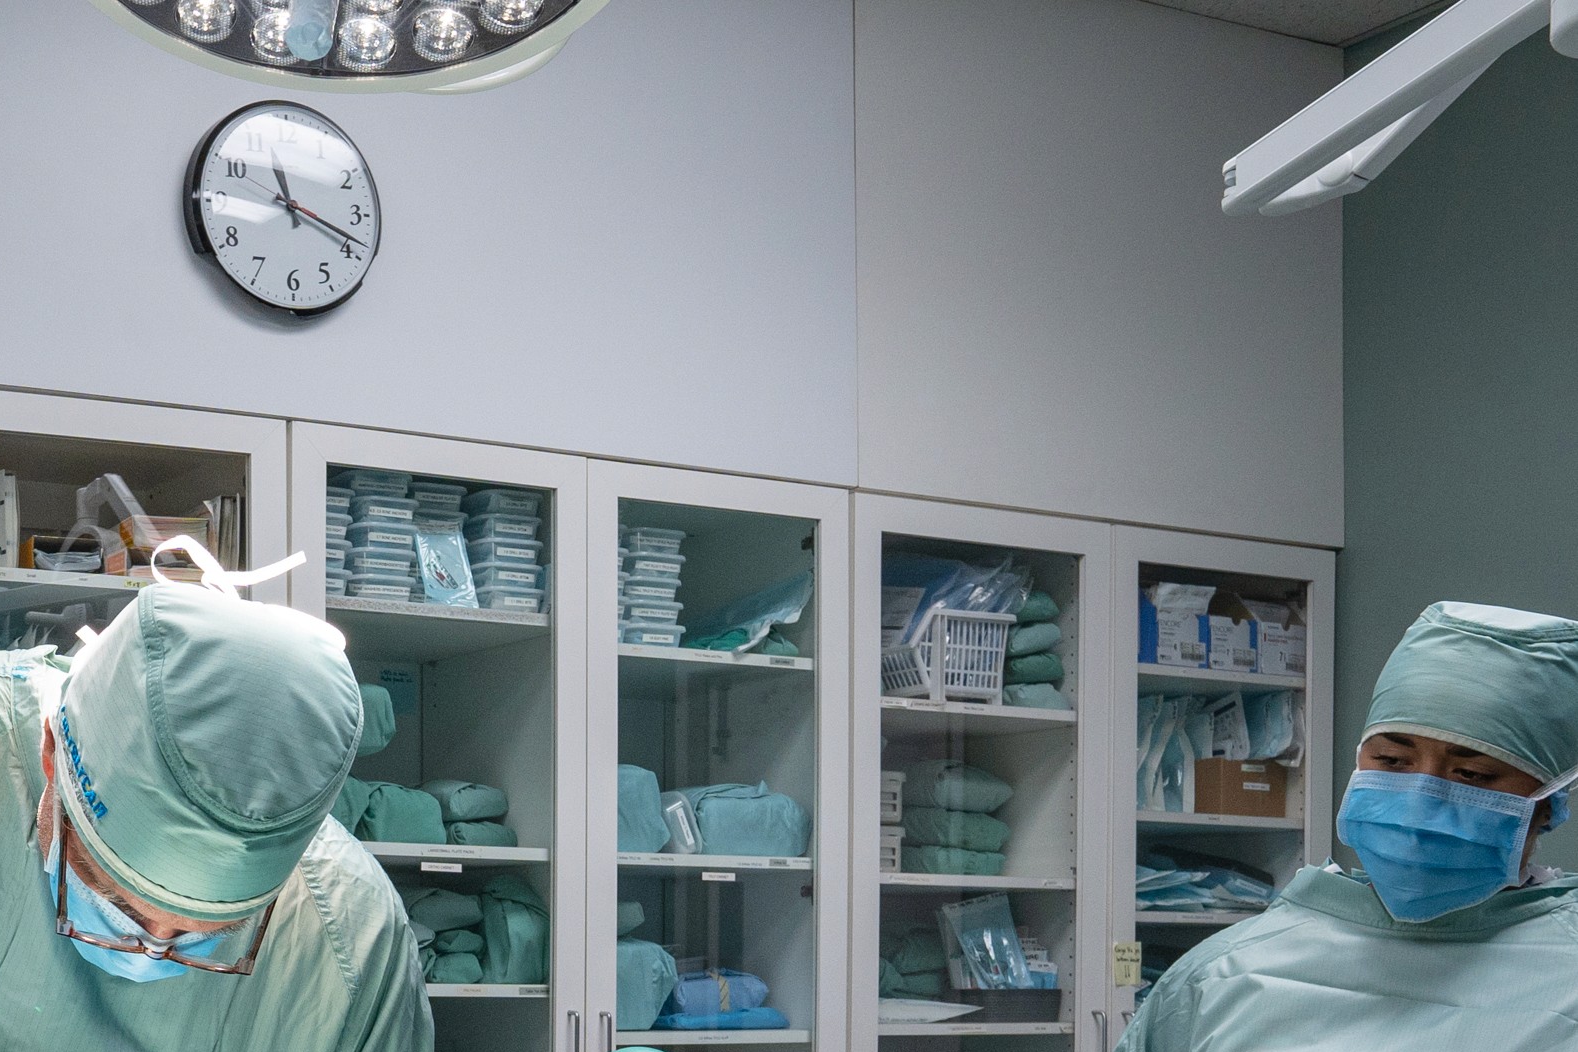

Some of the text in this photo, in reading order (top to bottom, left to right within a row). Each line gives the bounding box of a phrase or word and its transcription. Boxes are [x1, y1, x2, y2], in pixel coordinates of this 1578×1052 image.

[246, 131, 263, 152] 11
[278, 123, 297, 143] 12
[316, 139, 326, 159] 1
[225, 157, 246, 178] 10
[340, 170, 353, 190] 2
[215, 191, 227, 212] 9
[350, 205, 362, 225] 3
[226, 226, 239, 247] 8
[340, 238, 353, 259] 4
[252, 256, 266, 278] 7
[319, 262, 330, 284] 5
[287, 269, 300, 291] 6
